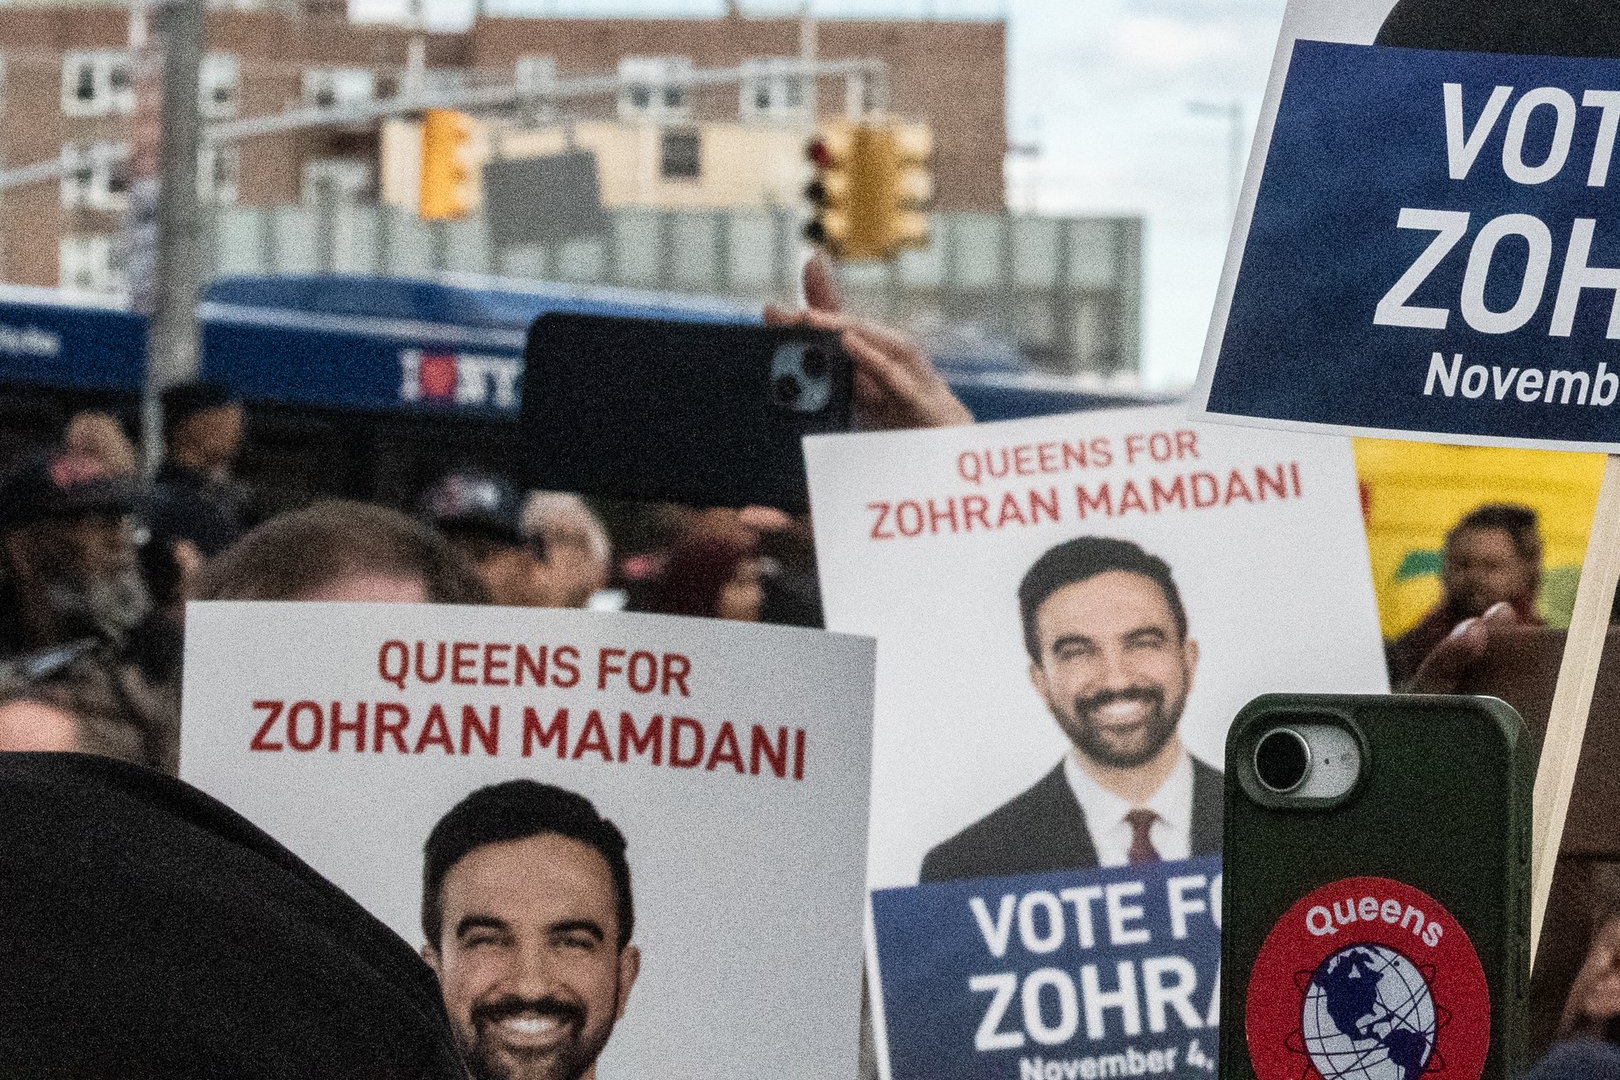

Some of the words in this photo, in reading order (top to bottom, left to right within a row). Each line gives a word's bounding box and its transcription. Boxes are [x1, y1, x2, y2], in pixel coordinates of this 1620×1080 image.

[957, 437, 1113, 483] QUEENS
[1126, 429, 1201, 465] FOR
[867, 486, 1061, 540] ZOHRAN
[1075, 461, 1302, 520] MAMDANI
[377, 639, 582, 691] QUEENS
[597, 647, 693, 697] FOR
[249, 699, 502, 757] ZOHRAN
[521, 706, 806, 781] MAMDANI
[968, 879, 1152, 959] VOTE
[1304, 895, 1445, 949] Queens
[968, 955, 1220, 1052] ZOHR
[1019, 1047, 1177, 1080] November
